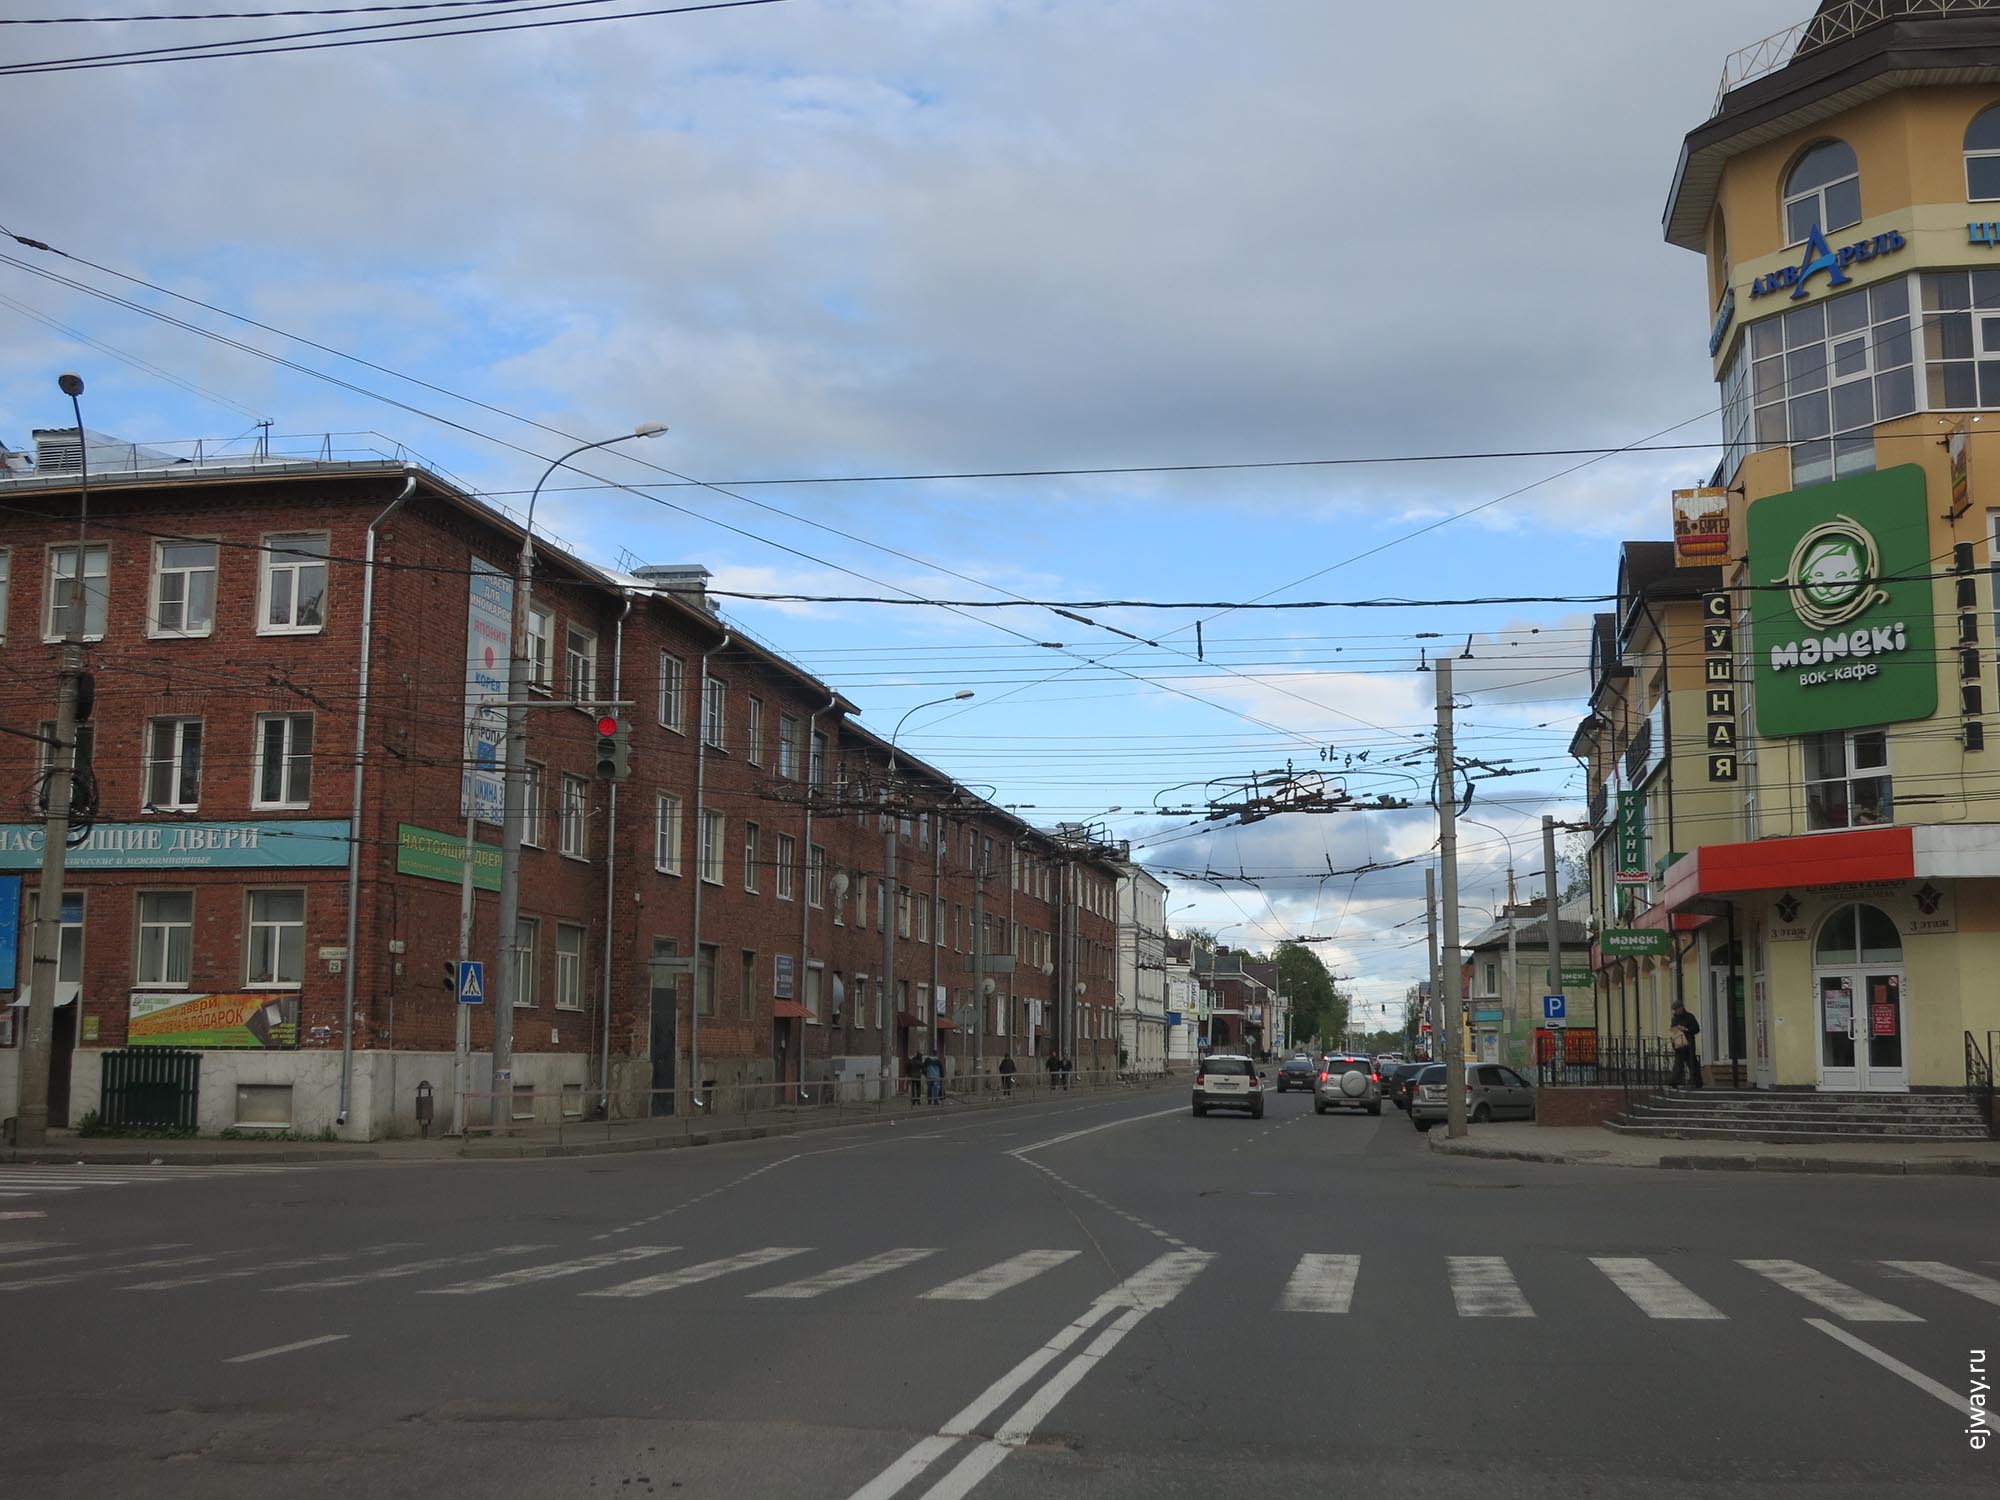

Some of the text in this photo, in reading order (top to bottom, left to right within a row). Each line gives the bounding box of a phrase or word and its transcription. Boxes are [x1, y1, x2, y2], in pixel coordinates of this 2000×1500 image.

[1968, 221, 2000, 247] Ц
[1750, 224, 1906, 300] АКВАРЕЛЬ
[1699, 518, 1729, 533] БУРГЕР
[470, 591, 512, 622] ИНОМАРОК
[484, 585, 501, 602] ДЛЯ
[474, 617, 507, 645] ЯПОНИЯ
[1709, 597, 1731, 777] СУШНАЯ
[1800, 662, 1877, 686] вок-кафе
[168, 828, 260, 853] ДВЕРИ
[402, 833, 465, 861] НАСТОЯЩИ
[191, 1007, 244, 1031] ПОДАРОК
